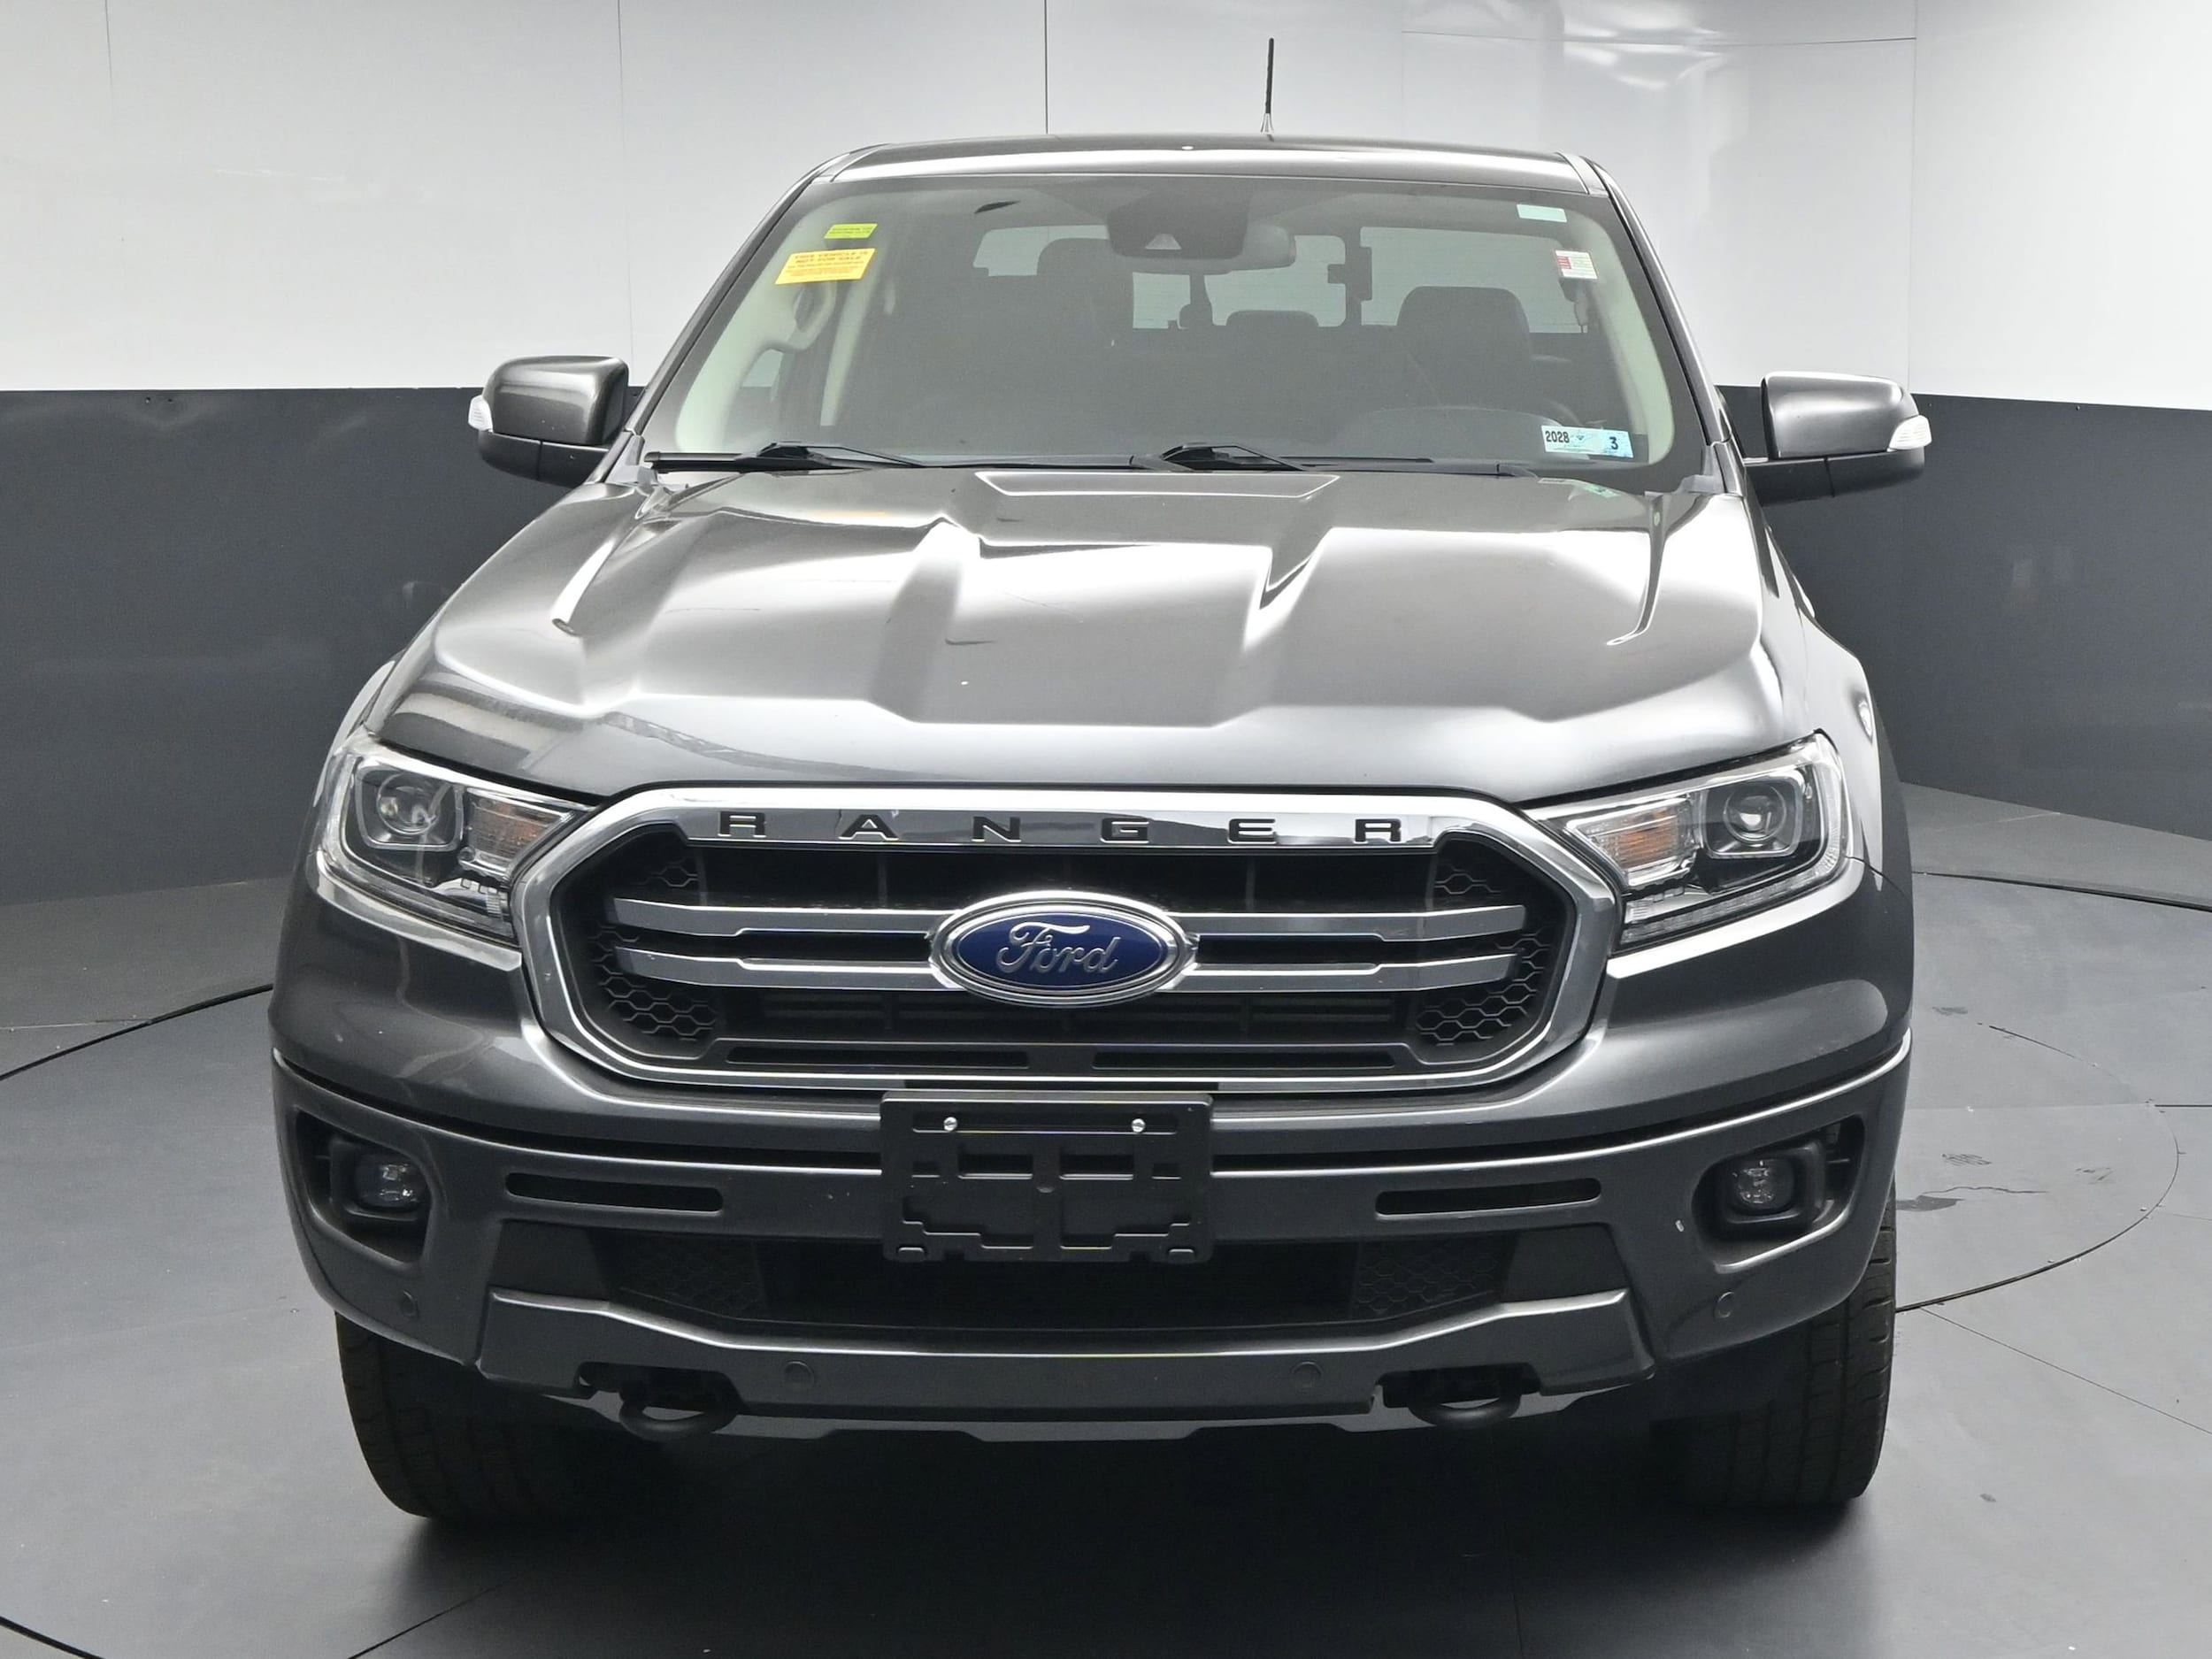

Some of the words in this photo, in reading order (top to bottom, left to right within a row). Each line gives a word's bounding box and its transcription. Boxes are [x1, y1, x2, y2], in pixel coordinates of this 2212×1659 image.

[1545, 430, 1570, 443] 2028
[1609, 436, 1618, 450] 3
[718, 810, 1402, 844] RANGER
[995, 921, 1121, 973] Ford
